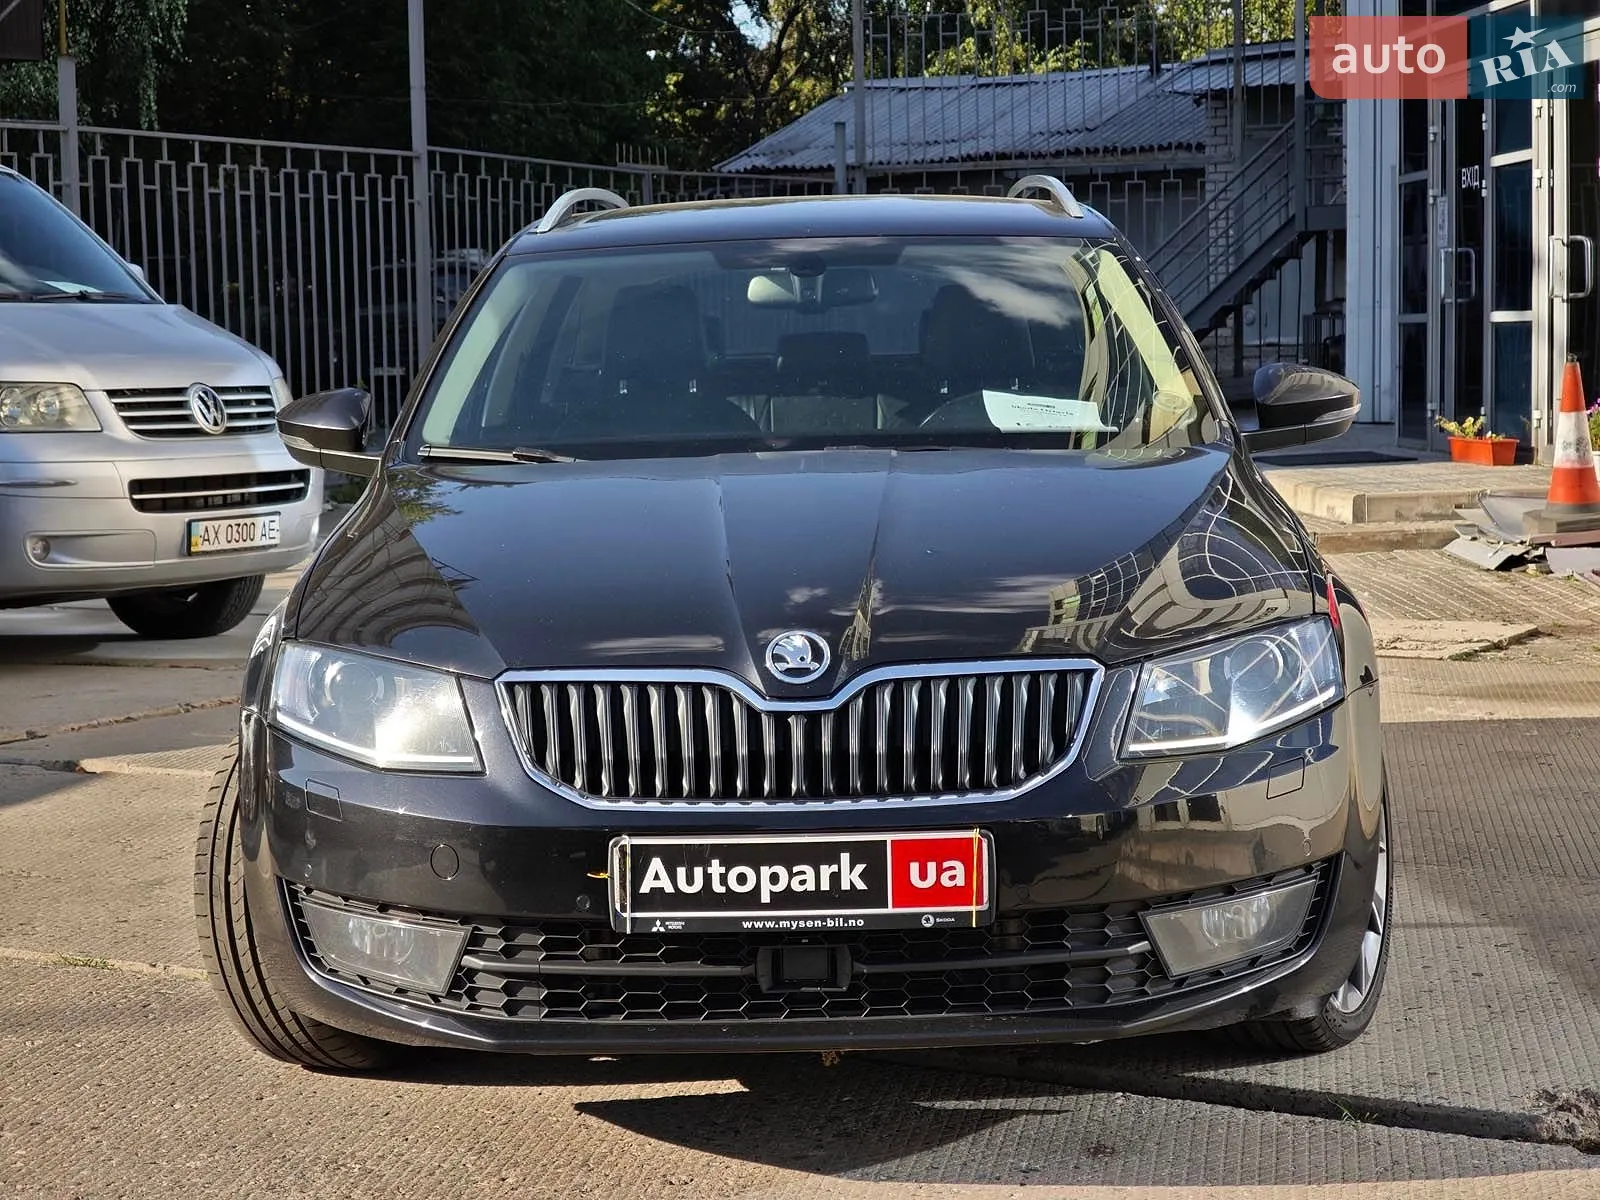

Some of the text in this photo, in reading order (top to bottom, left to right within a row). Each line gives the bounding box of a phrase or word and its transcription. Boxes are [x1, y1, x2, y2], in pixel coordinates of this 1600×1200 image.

[201, 519, 276, 546] AX 0300 AE
[638, 852, 966, 904] Autopark ua
[742, 916, 865, 930] www.mysen-bil.no
